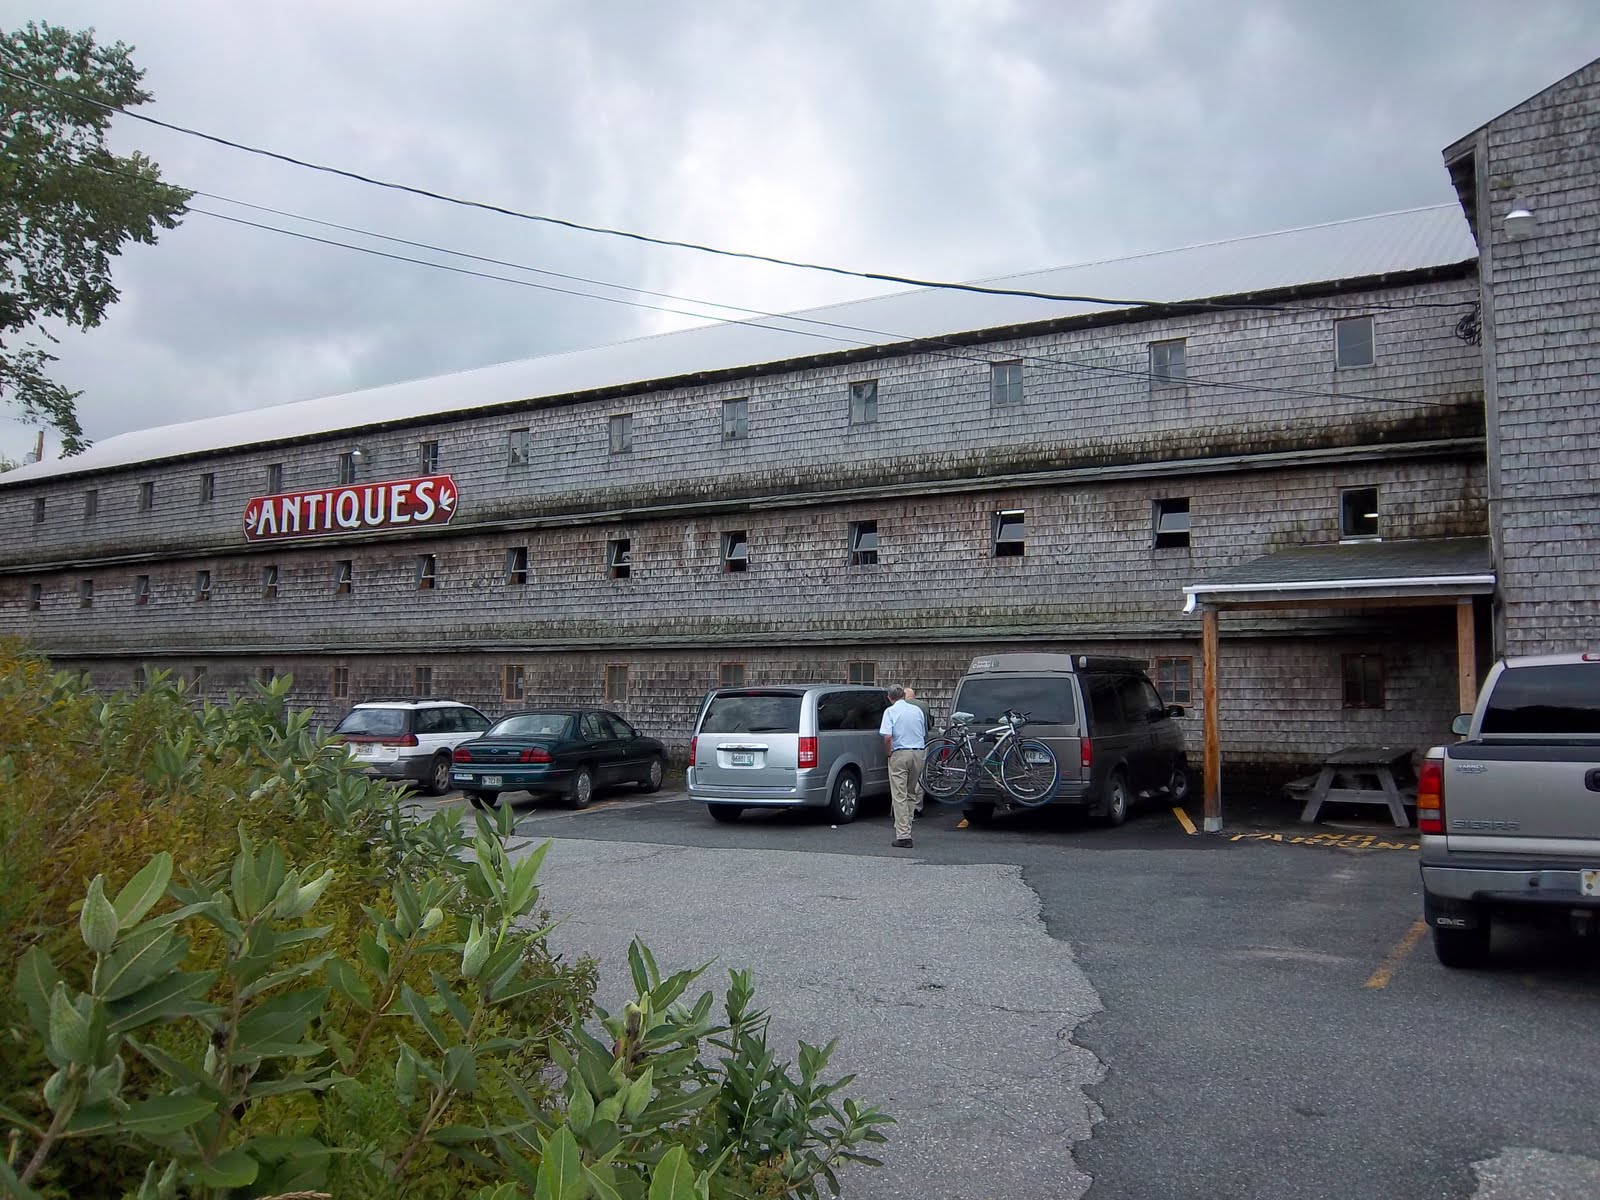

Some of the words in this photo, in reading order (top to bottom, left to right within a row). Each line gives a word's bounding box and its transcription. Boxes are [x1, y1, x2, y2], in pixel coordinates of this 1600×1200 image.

[256, 481, 436, 535] ANTIQUES
[1452, 819, 1520, 831] SIERRA
[1437, 917, 1465, 926] GMC
